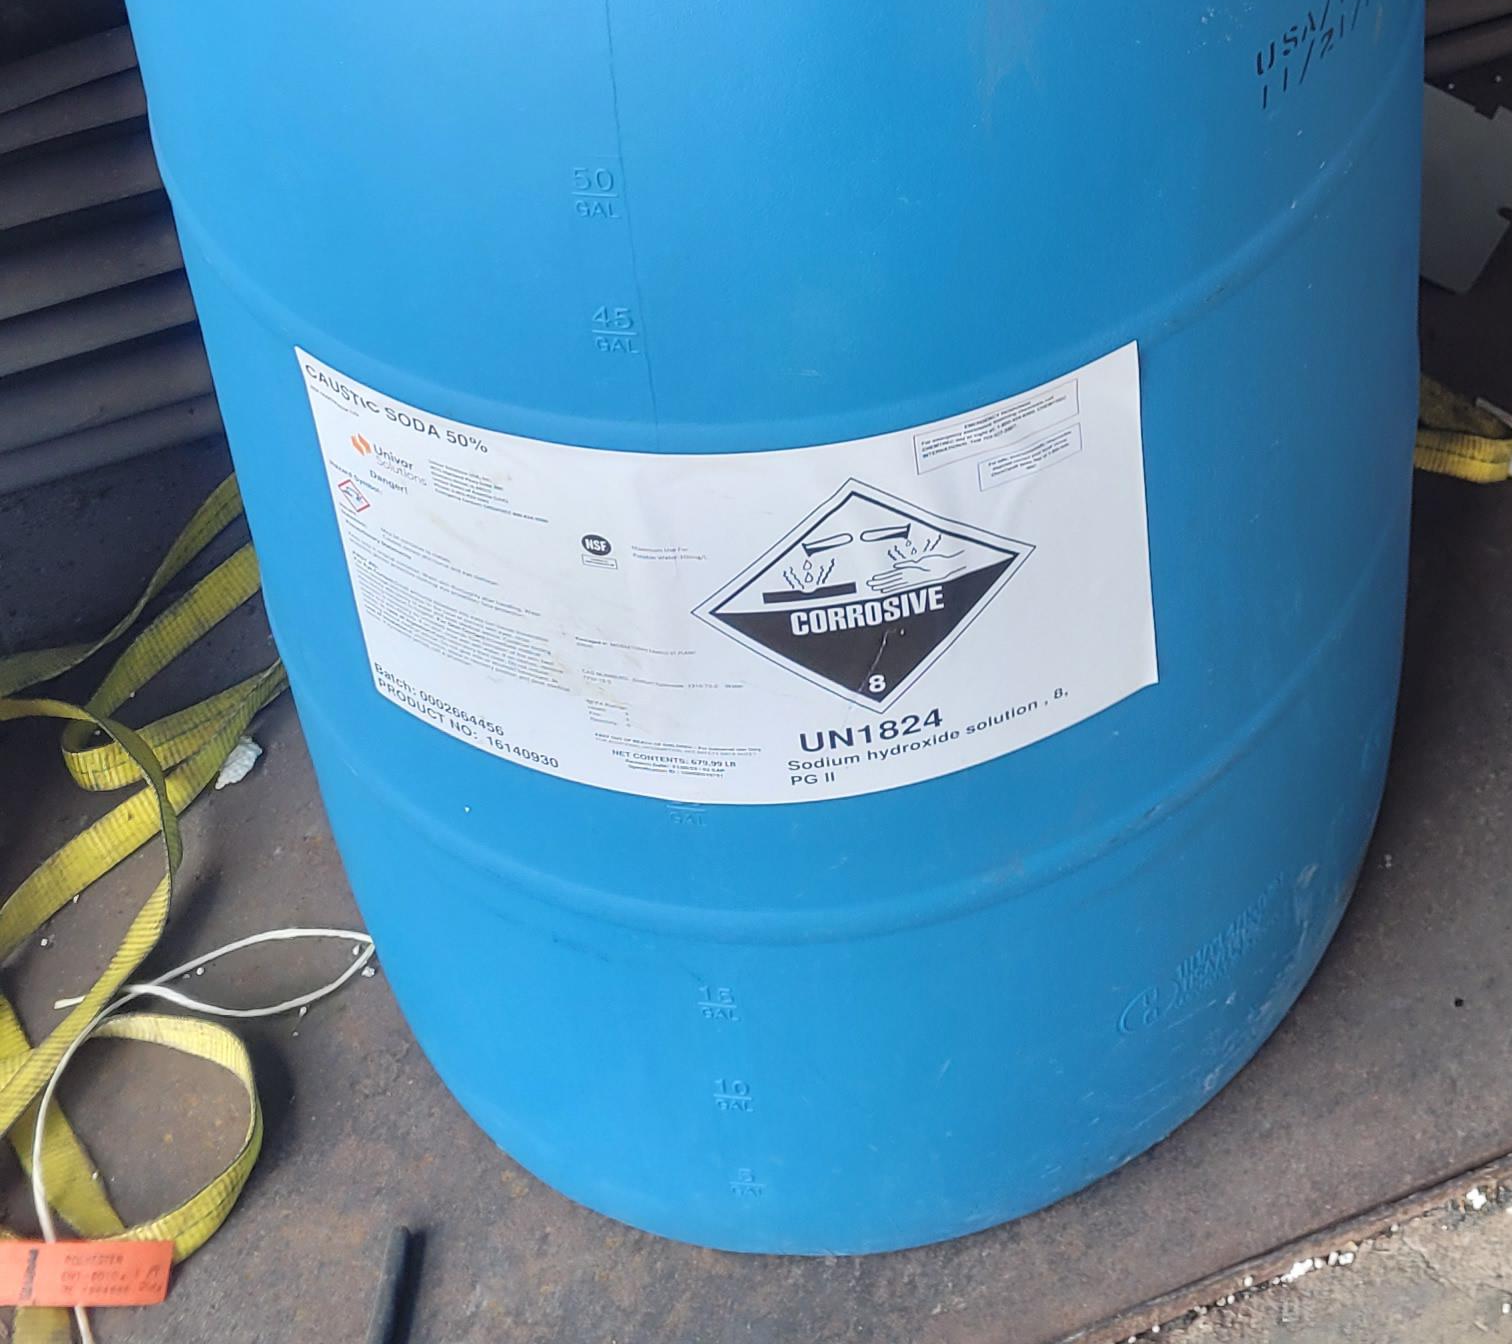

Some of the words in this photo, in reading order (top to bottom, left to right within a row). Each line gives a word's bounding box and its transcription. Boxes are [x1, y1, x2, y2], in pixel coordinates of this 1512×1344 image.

[572, 167, 615, 192] 50
[575, 199, 622, 219] GAL
[592, 305, 634, 330] 45
[595, 336, 640, 354] GAL
[305, 364, 381, 413] CAUSTIC
[385, 407, 441, 439] SODA
[446, 430, 489, 454] 50%
[373, 443, 414, 471] Univar
[376, 457, 428, 486] Solutions
[370, 469, 409, 495] Danger!
[584, 538, 608, 552] NSF
[790, 585, 945, 636] CORROSIVE
[868, 674, 886, 693] 8
[374, 662, 417, 695] Batch:
[420, 690, 504, 736] 0002664456
[378, 677, 445, 723] PRODUCT
[450, 719, 480, 740] NO:
[487, 736, 559, 768] 16140930
[799, 707, 943, 753] UN1824
[788, 754, 860, 771] Sodium
[867, 730, 961, 761] hydroxide
[966, 700, 1038, 735] solution
[611, 749, 630, 758] NET
[633, 753, 689, 765] CONTENTS:
[691, 759, 722, 767] 679.99
[725, 760, 737, 768] LB
[791, 775, 818, 786] PG
[825, 772, 835, 783] II
[669, 810, 708, 828] GAL
[698, 985, 735, 1004] 15
[701, 1006, 742, 1023] GAL
[714, 1078, 750, 1097] 10
[715, 1098, 755, 1114] GAL
[737, 1168, 755, 1182] 5
